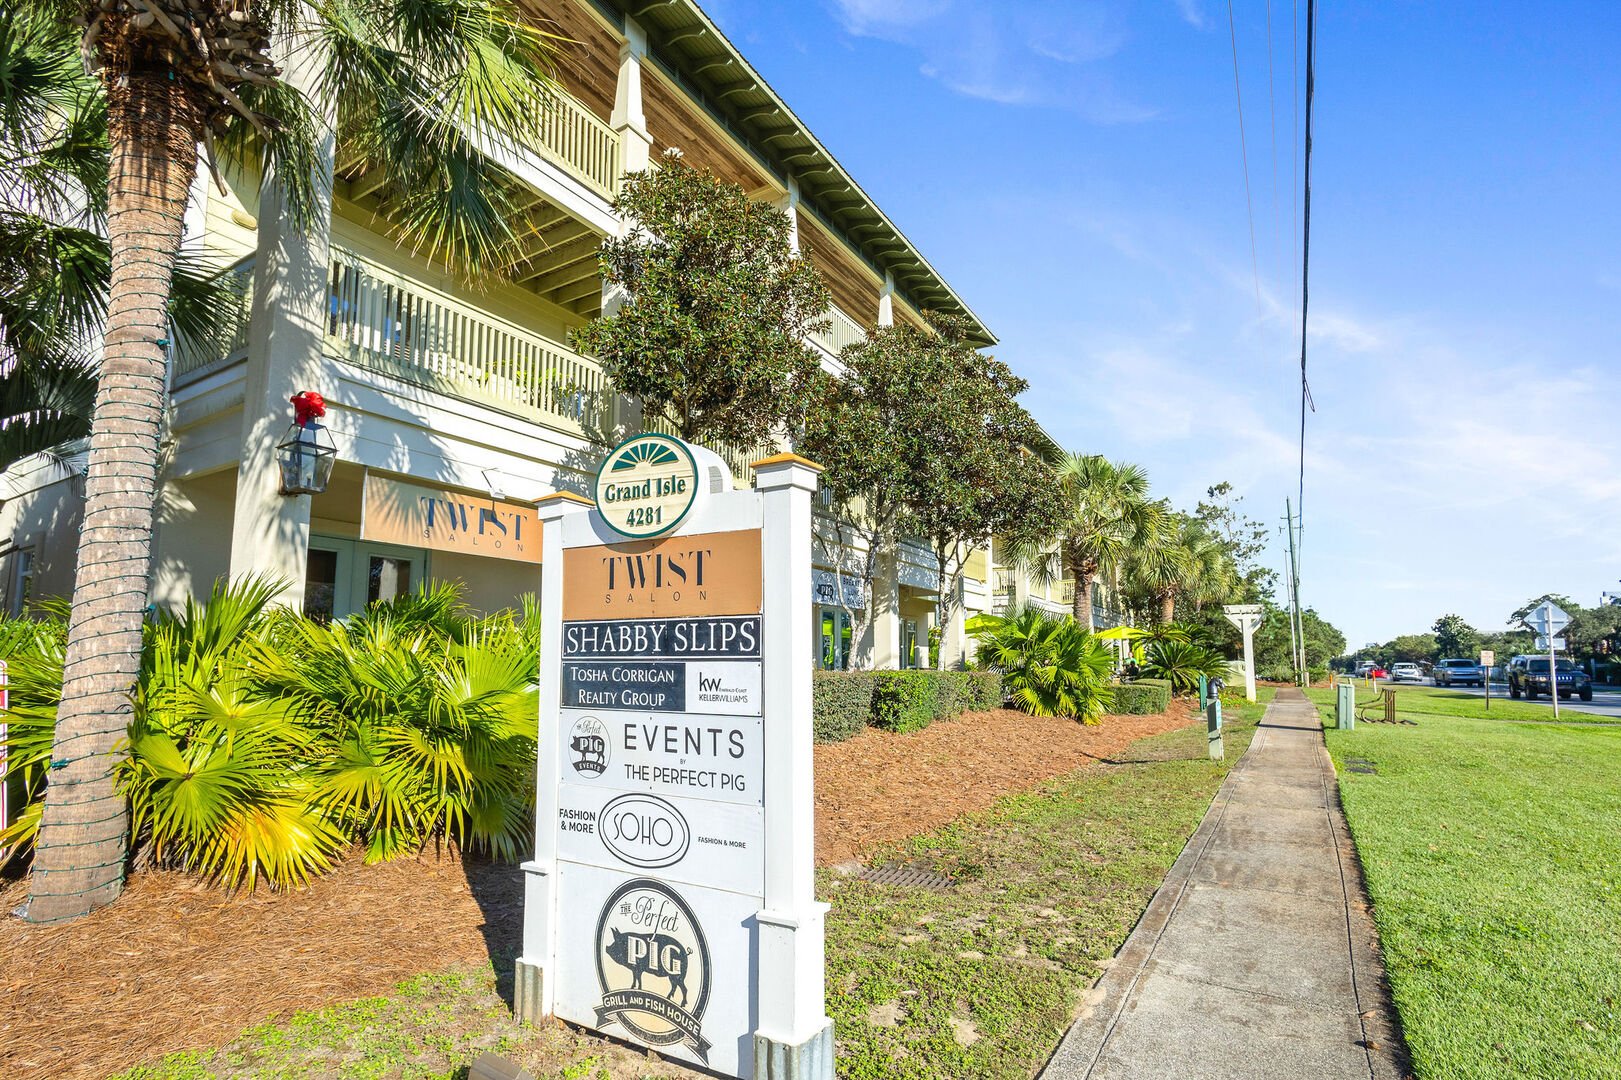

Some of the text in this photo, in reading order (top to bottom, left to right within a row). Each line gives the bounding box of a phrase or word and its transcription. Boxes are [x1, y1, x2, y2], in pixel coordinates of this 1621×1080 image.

[605, 474, 686, 503] Grand Isle
[420, 496, 528, 541] TWIST
[626, 505, 662, 527] 4281
[423, 529, 524, 552] SALON
[602, 550, 712, 590] TWIST
[605, 590, 707, 604] SALON
[566, 621, 756, 653] SHABBY SLIPS
[570, 666, 675, 683] TOSHA CORRIGAN
[578, 688, 666, 706] REALTY GROUP
[579, 737, 603, 752] PIG
[624, 723, 745, 759] EVENTS
[578, 762, 601, 772] EVENTS
[624, 764, 746, 792] THE PERFECT PIG
[558, 808, 596, 822] FASHION
[560, 820, 594, 834] & MORE
[613, 812, 673, 847] SOHO
[697, 836, 723, 846] FASHION
[728, 840, 747, 849] MORE
[620, 896, 679, 942] THE Perfect
[627, 935, 681, 975] PIG
[603, 995, 700, 1036] GRILL AND FISH HOUSE
